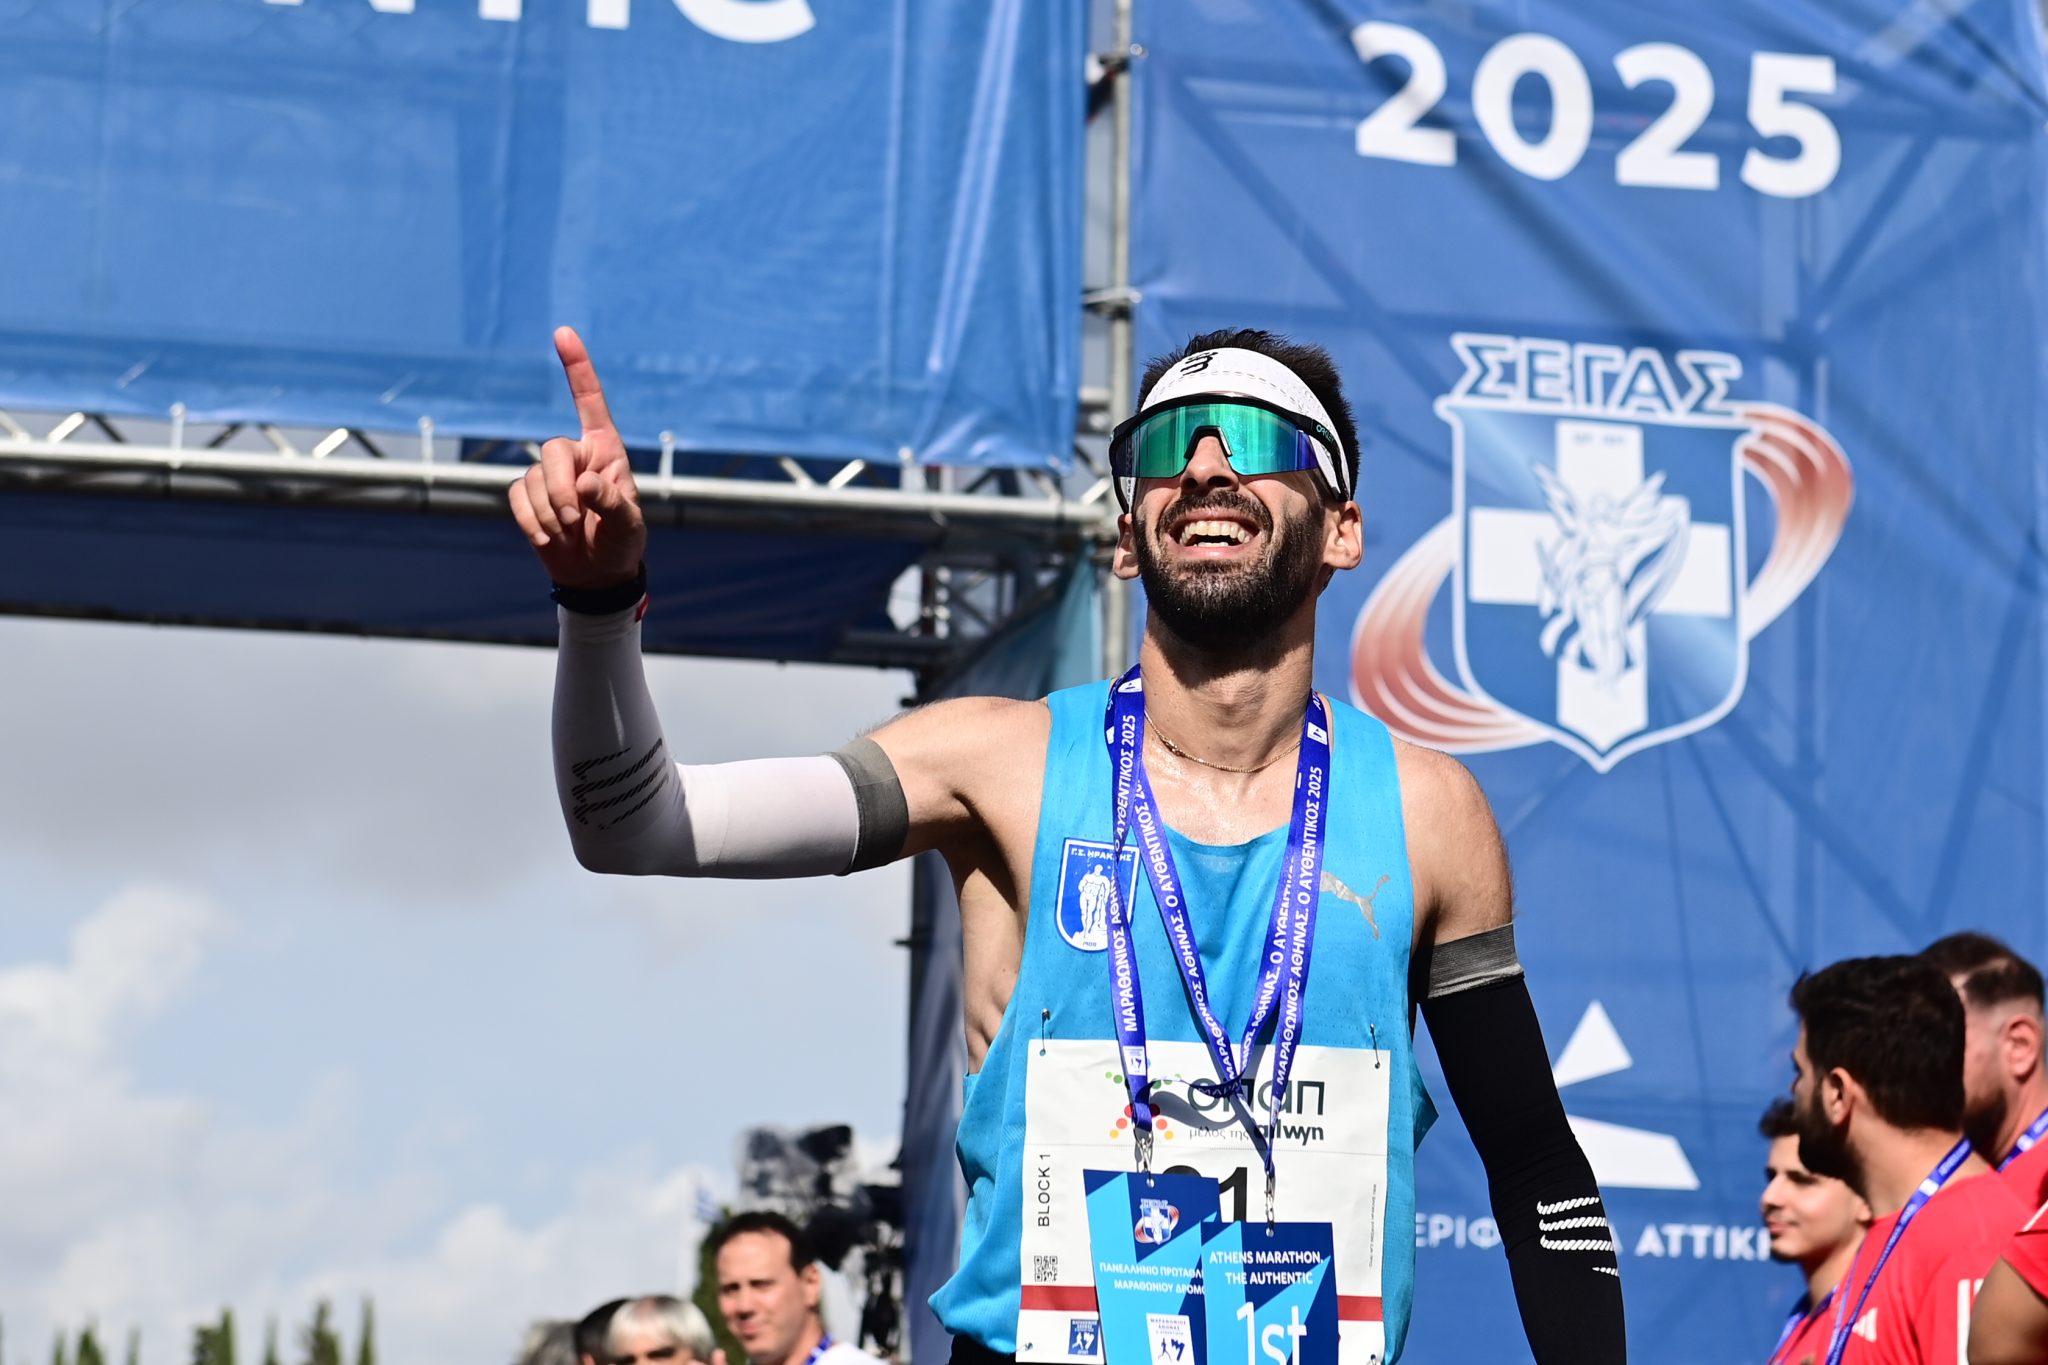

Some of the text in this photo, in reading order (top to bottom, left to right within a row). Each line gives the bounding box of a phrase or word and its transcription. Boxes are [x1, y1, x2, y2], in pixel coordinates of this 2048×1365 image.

[1354, 21, 1842, 199] 2025
[1449, 331, 1745, 417] ΣΕΓΑΣ
[1122, 715, 1136, 747] 2025
[1116, 749, 1134, 838] ΑΥΘΕΝΤΙΚΟΣ
[1308, 766, 1323, 797] 2025
[1087, 850, 1133, 861] ΗΡΑΚΗΣ
[1134, 801, 1175, 892] ΑΥΘΕΝΤΙΚΟΣ
[1299, 801, 1320, 890] ΑΥΘΕΝΤΙΚΟΣ
[1165, 895, 1179, 908] Ο
[1297, 892, 1310, 905] Ο
[1113, 926, 1137, 1032] ΜΑΡΑΘΩΝΙΟΣ
[1270, 951, 1284, 964] Ο
[1192, 981, 1235, 1079] ΜΑΡΑΘΩΝΙΟΣ
[1277, 979, 1301, 1085] ΜΑΡΑΘΩΝΙΟΣ
[1038, 1167, 1050, 1227] BLOCK
[1100, 1262, 1159, 1275] ΠΑΝΕΛΛΗΝΙΟ
[1209, 1251, 1254, 1264] ATHENS
[1225, 1272, 1314, 1285] THE AUTHENTIC
[1114, 1280, 1174, 1293] ΜΑΡΑΘΩΝΙΟΥ
[1236, 1301, 1307, 1365] 1st
